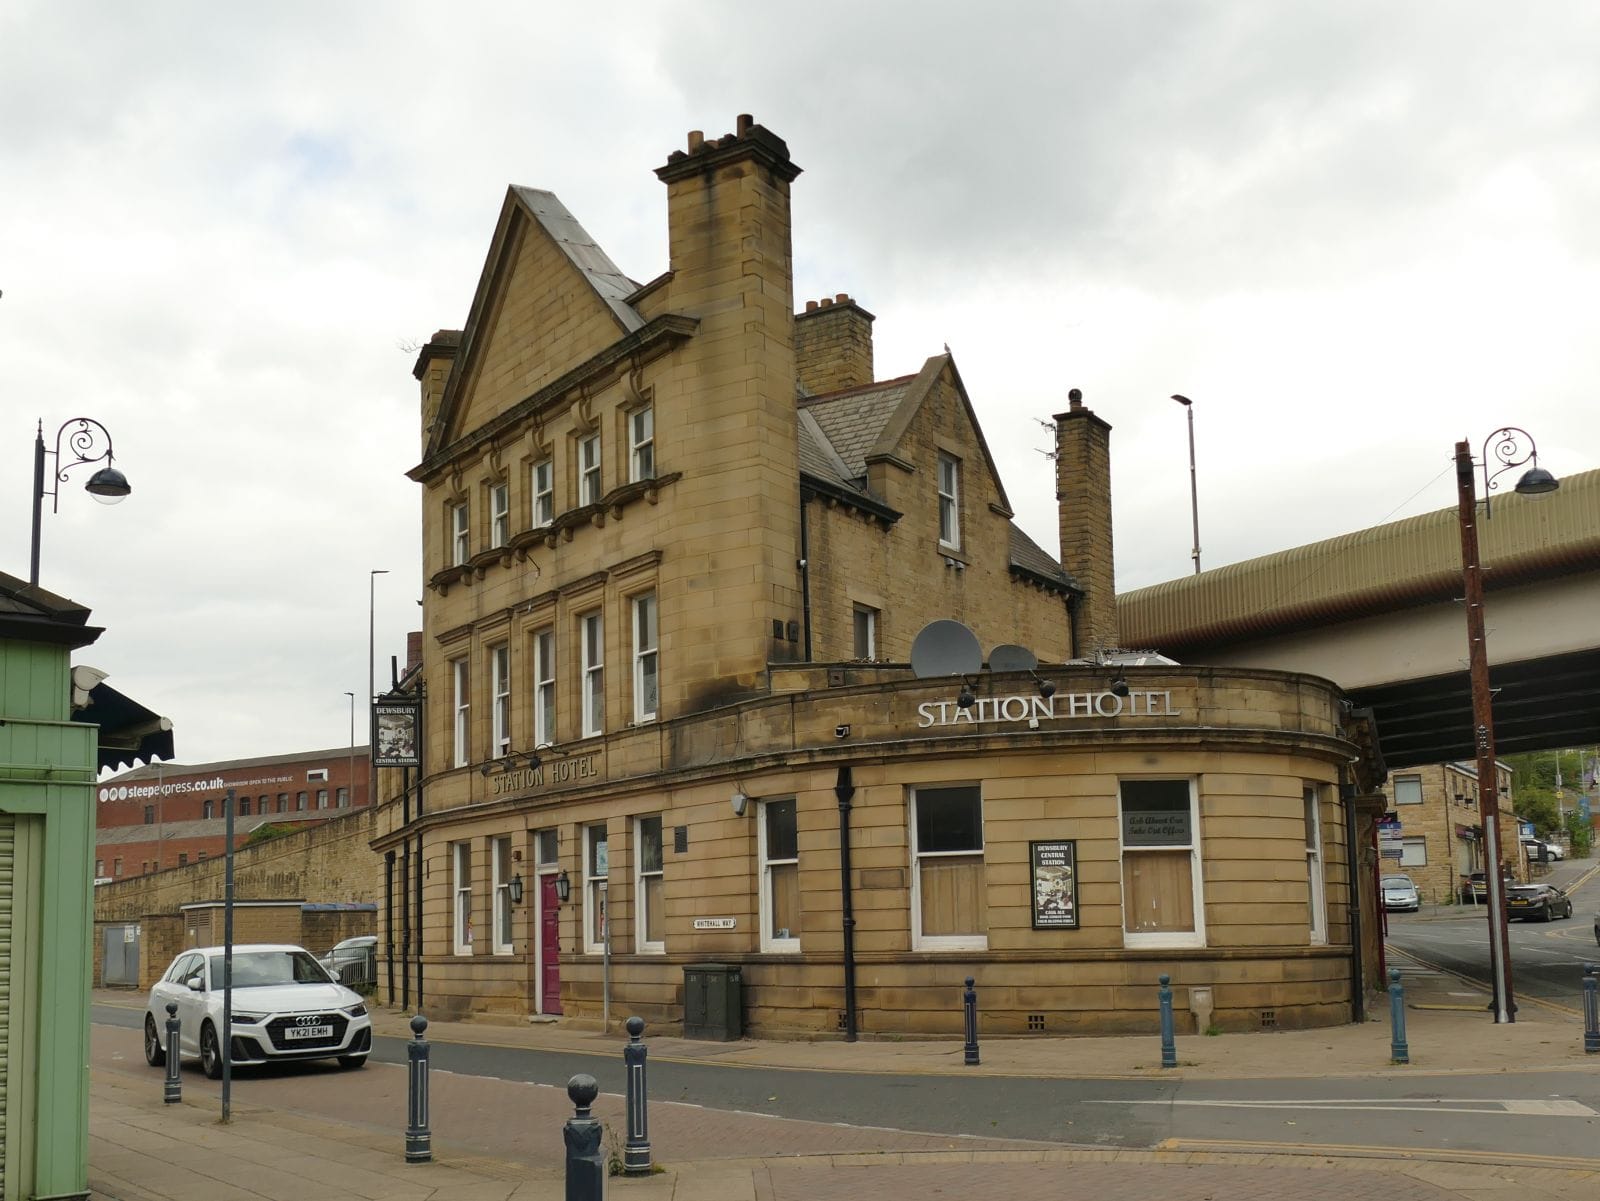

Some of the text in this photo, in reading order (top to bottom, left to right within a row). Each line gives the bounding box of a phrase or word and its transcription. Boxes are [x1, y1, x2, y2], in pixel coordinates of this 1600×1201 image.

[918, 691, 1182, 728] STATION HOTEL
[127, 776, 224, 798] sleepexpress.co.uk
[493, 756, 598, 794] STATION HOTEL
[290, 1027, 328, 1037] YK21 EMH
